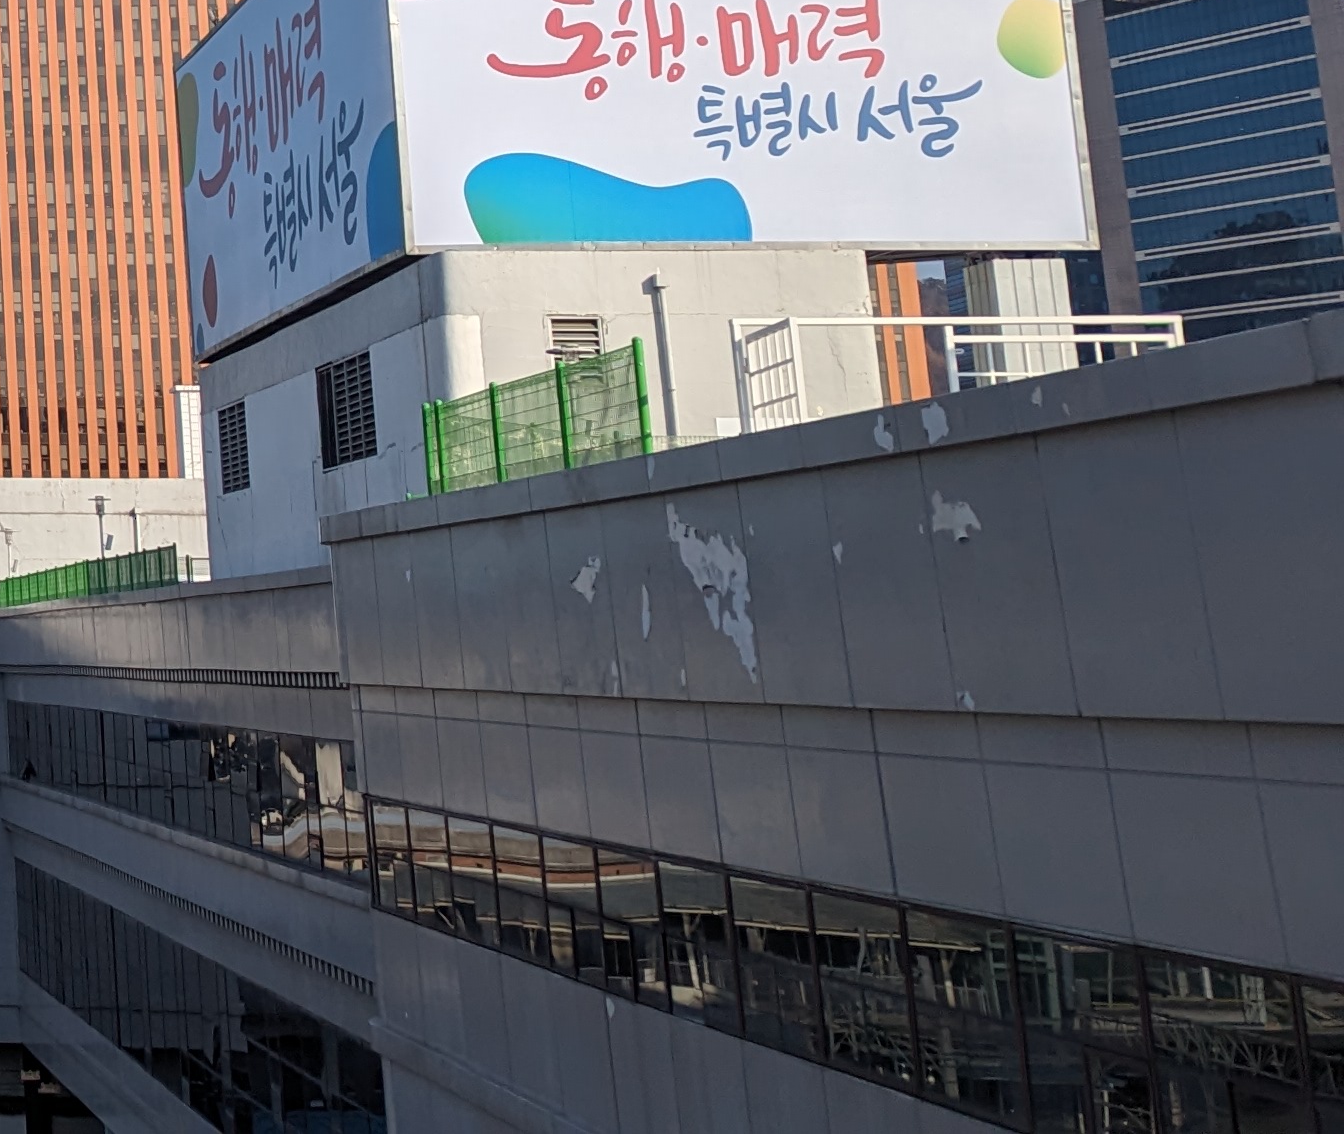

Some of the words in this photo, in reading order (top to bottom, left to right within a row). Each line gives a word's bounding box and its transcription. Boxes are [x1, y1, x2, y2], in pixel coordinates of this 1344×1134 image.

[693, 81, 840, 162] 특별시
[857, 73, 984, 158] 서울
[264, 148, 312, 290] 특별시
[318, 97, 364, 246] 서울
